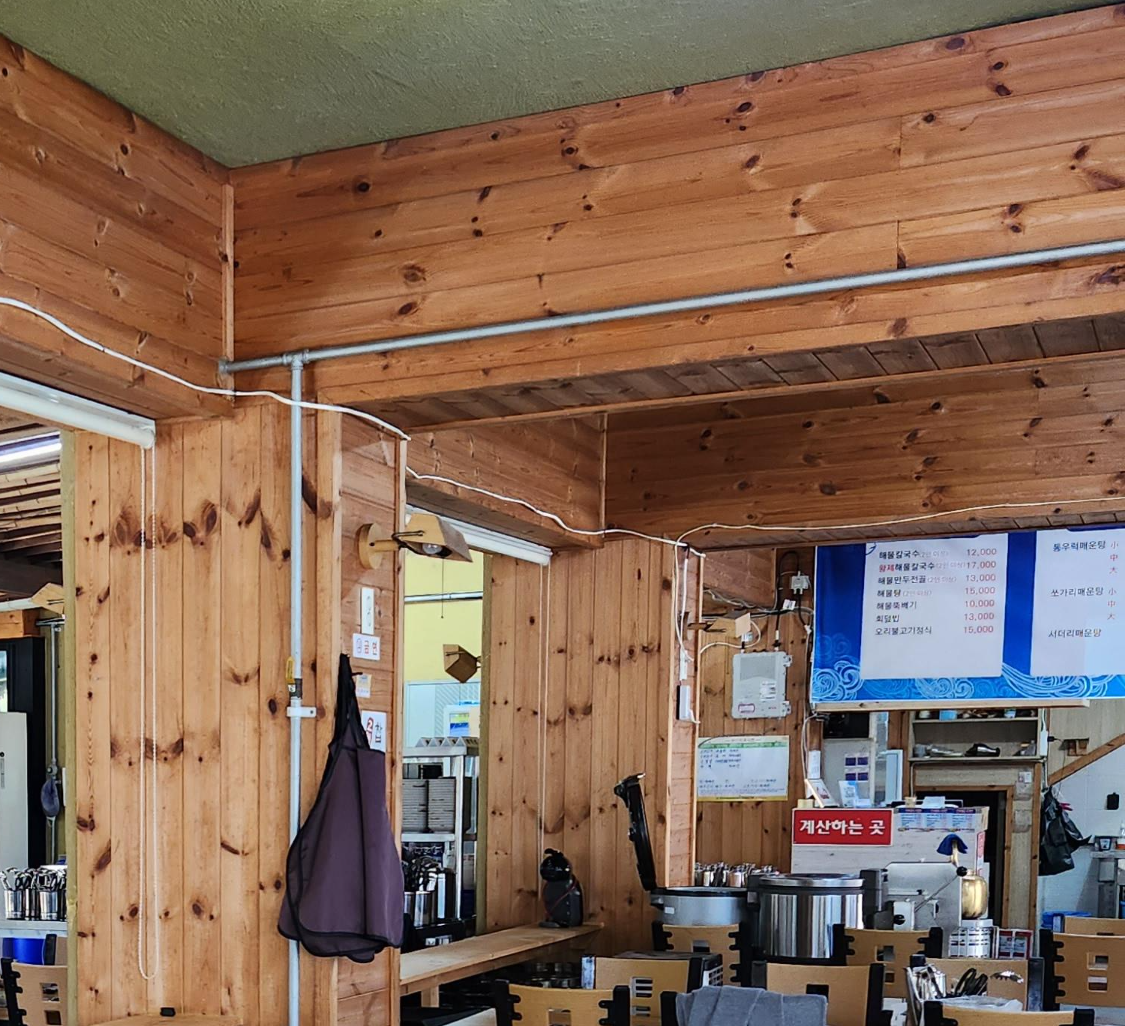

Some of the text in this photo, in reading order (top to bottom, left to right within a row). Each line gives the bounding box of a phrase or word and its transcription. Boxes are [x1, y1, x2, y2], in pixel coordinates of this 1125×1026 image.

[966, 548, 996, 557] 12,000
[966, 560, 996, 569] 17,000
[878, 575, 926, 585] 해물만두전골
[966, 574, 996, 583] 13,000
[965, 587, 995, 596] 15,000
[876, 599, 995, 611] 해물뚝배기 10,000
[964, 612, 994, 621] 13,000
[875, 625, 994, 636] 오리불고기정식 15,000
[799, 819, 864, 836] 계산하는
[868, 820, 885, 836] 곳
